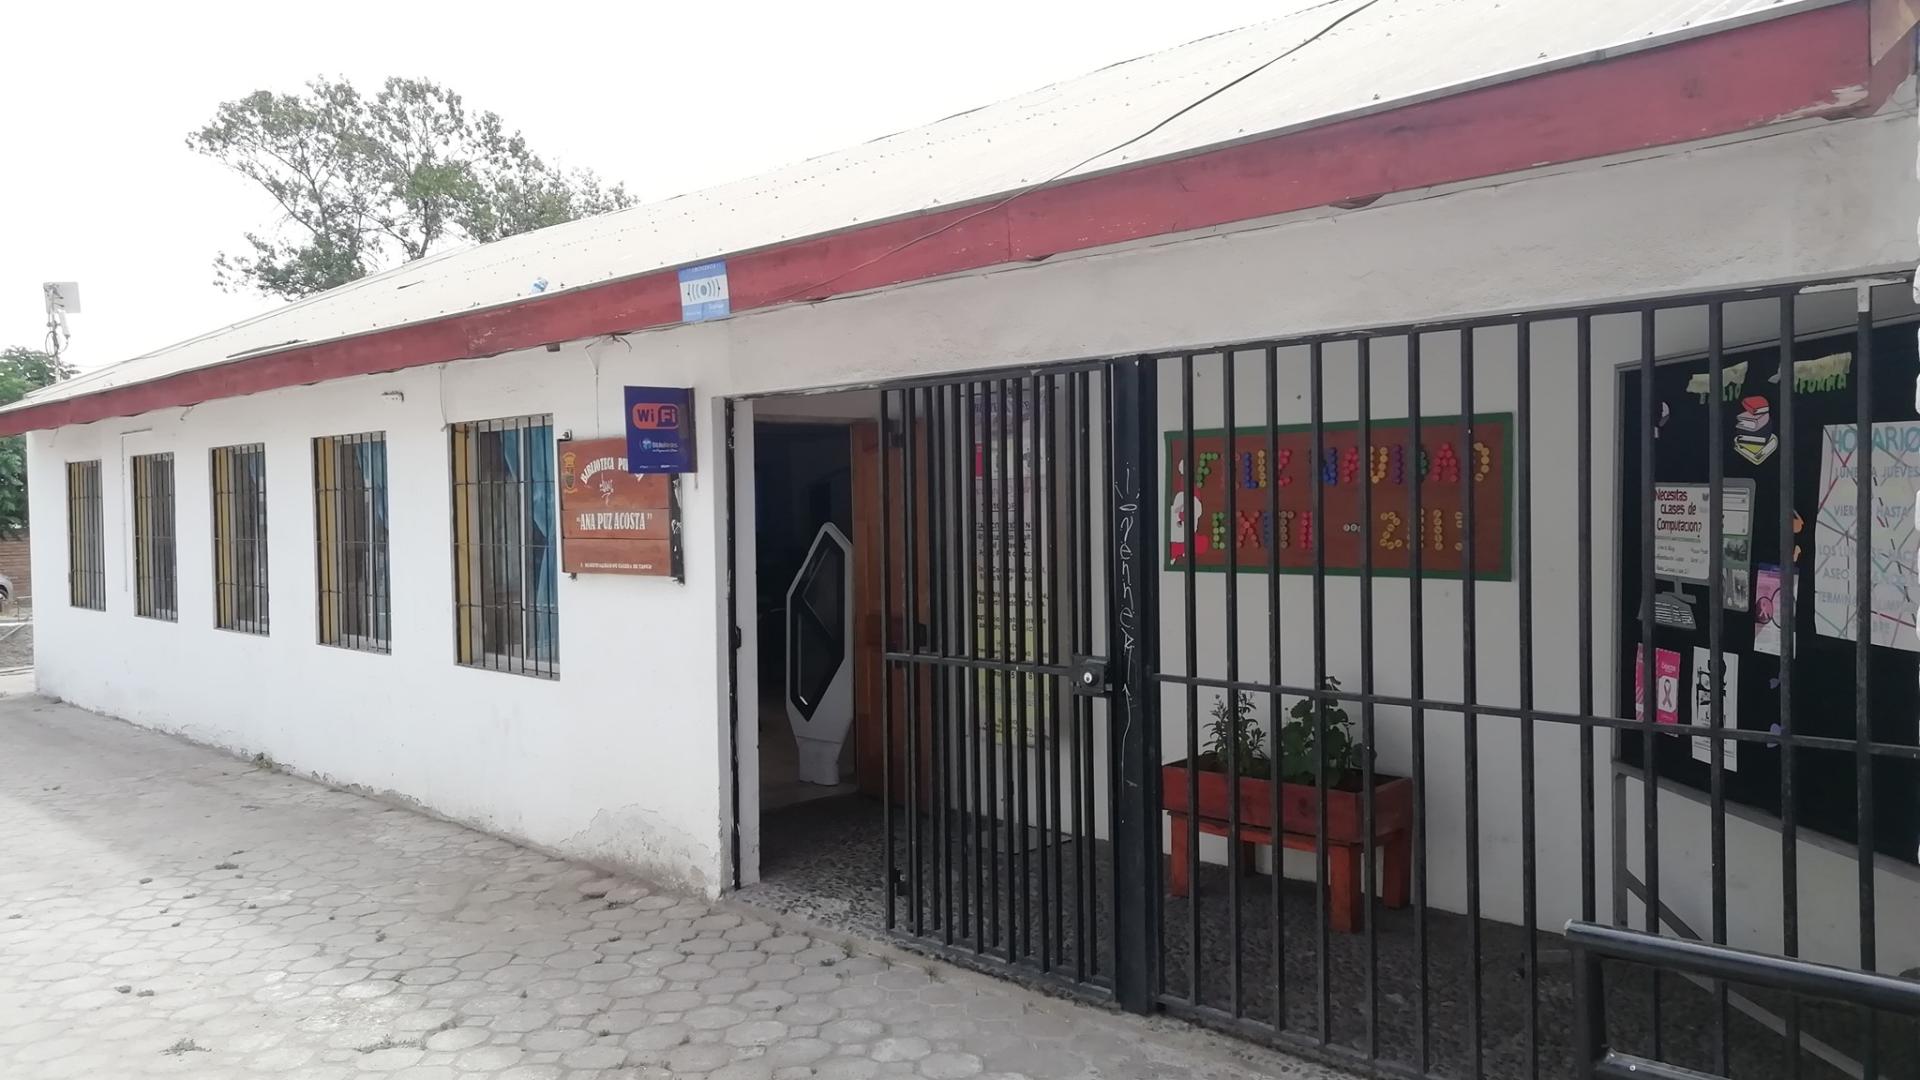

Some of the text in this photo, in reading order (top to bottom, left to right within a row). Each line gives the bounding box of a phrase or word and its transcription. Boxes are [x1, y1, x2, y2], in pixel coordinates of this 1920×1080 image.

[1831, 426, 1920, 453] HOARIO
[580, 457, 615, 485] BIBLIOTECA
[1197, 450, 1292, 488] FLIZ
[1836, 466, 1858, 479] LUNE
[1655, 489, 1688, 502] Necesitas
[1688, 501, 1697, 515] de
